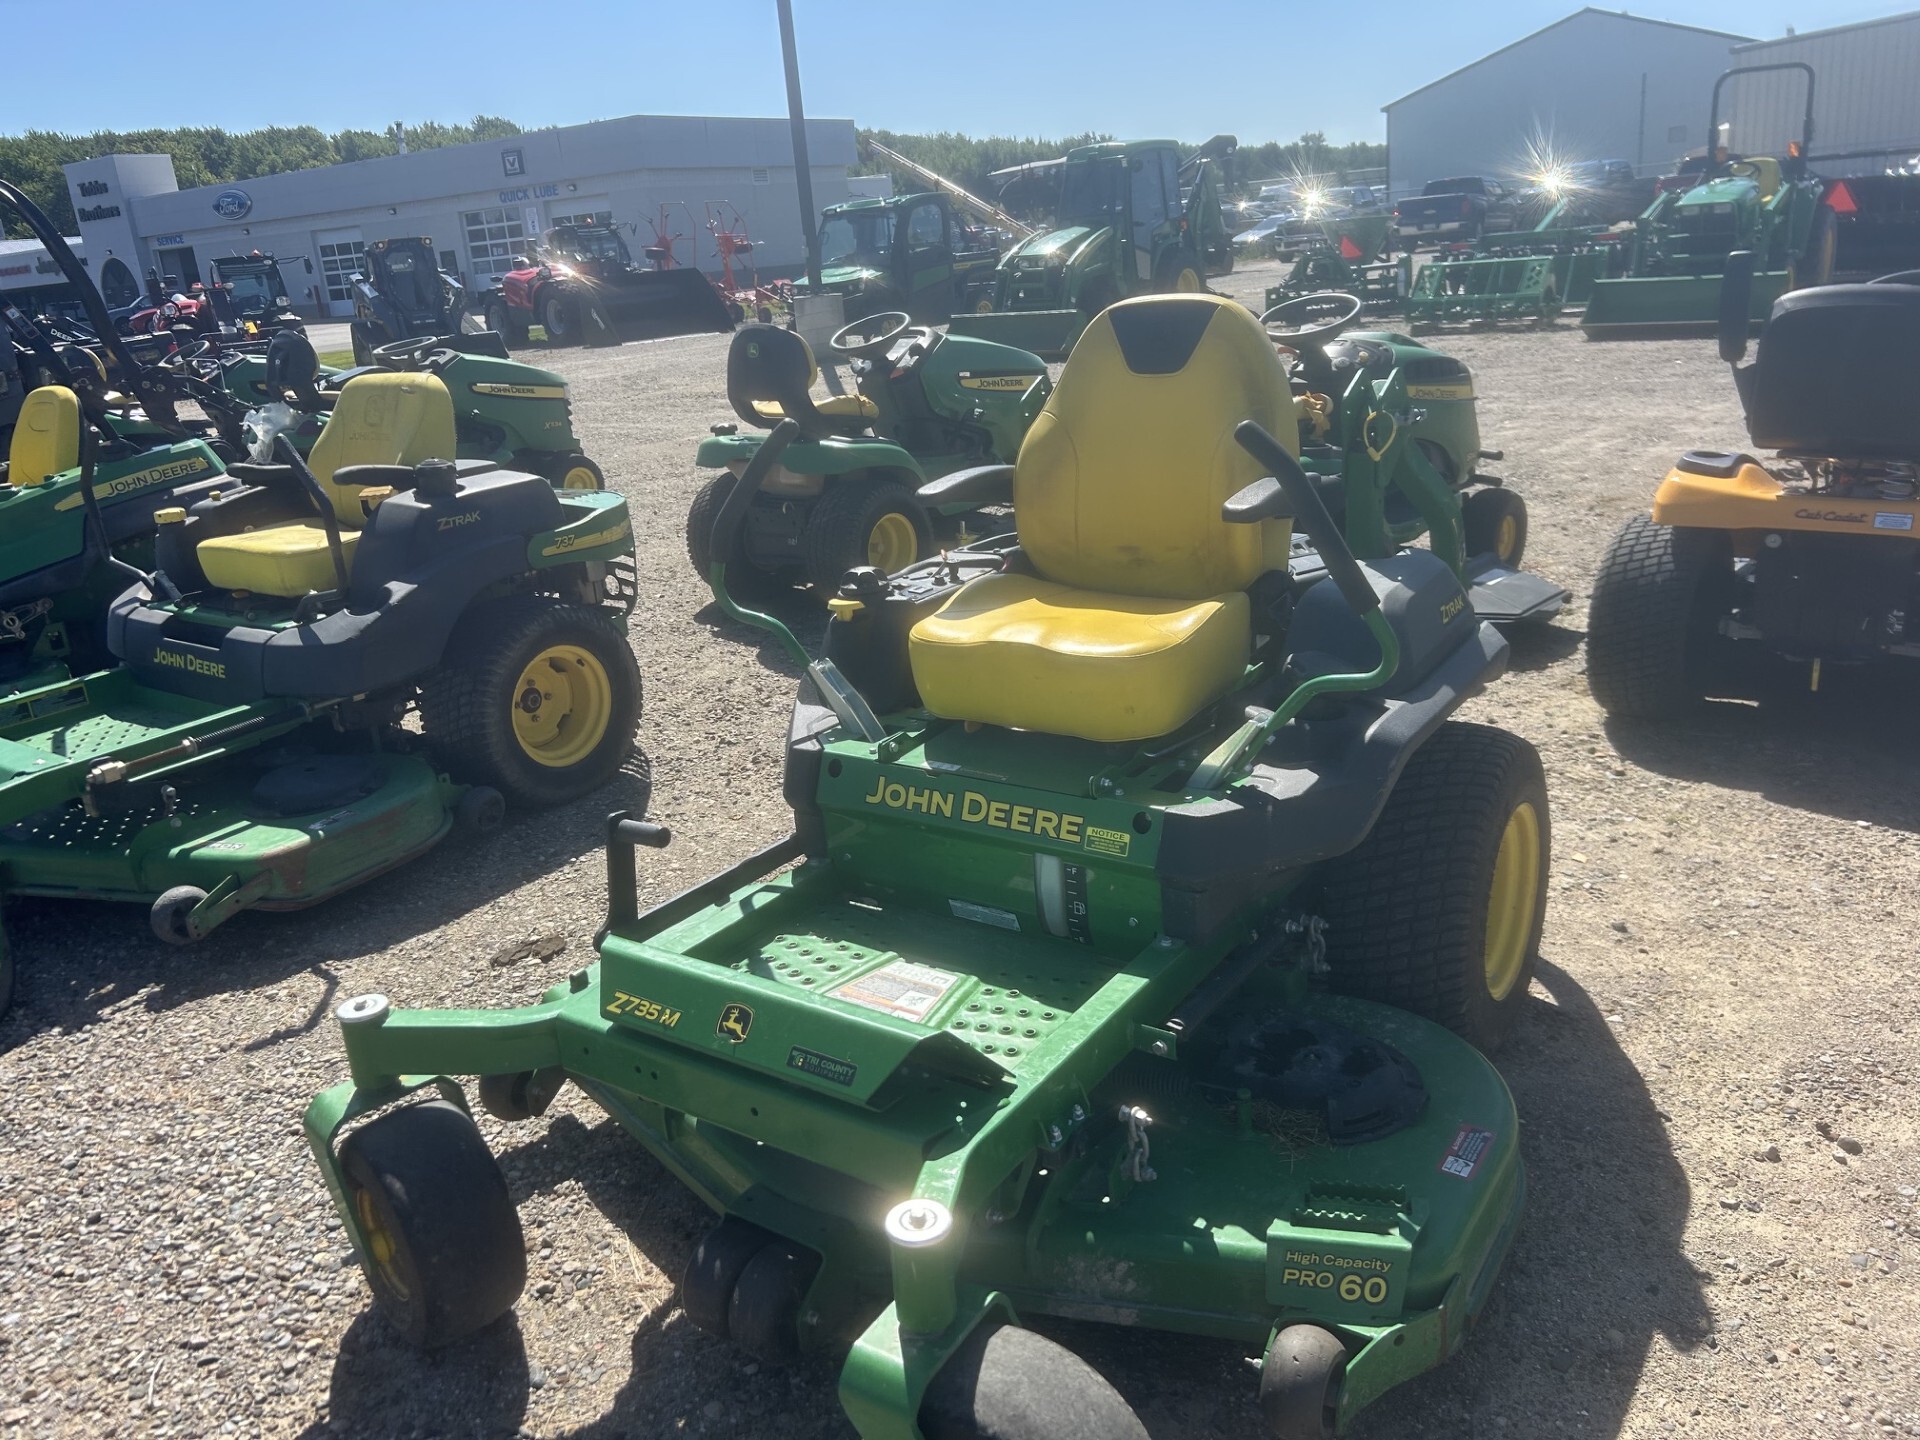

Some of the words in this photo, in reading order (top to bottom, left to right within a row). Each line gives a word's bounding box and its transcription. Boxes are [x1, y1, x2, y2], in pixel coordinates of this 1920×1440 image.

[499, 188, 530, 203] QUICK
[533, 184, 559, 199] LUBE
[157, 234, 184, 246] SERVICE
[50, 328, 76, 342] DEER
[488, 385, 510, 394] JOHN
[511, 386, 536, 394] DEERE
[977, 379, 1000, 389] JOHN
[1000, 379, 1024, 387] DEERE
[107, 474, 149, 496] JOHN
[149, 461, 198, 482] DEERE
[437, 510, 481, 531] ZTRAK
[555, 534, 575, 549] 737
[1440, 594, 1464, 624] ZTRAK
[153, 647, 185, 669] JOHN
[186, 653, 226, 679] DEERE
[865, 776, 954, 818] JOHN
[961, 791, 1084, 843] DEERE
[1091, 828, 1126, 841] NOTICE
[1071, 867, 1078, 875] F
[606, 991, 682, 1028] Z735M
[804, 1063, 853, 1083] EQUIPMENT
[806, 1054, 820, 1066] TRI
[820, 1060, 855, 1076] COUNTY
[1286, 1251, 1320, 1265] High
[1323, 1254, 1392, 1273] Capacity
[1282, 1268, 1334, 1288] PRO
[1339, 1274, 1387, 1303] 60
